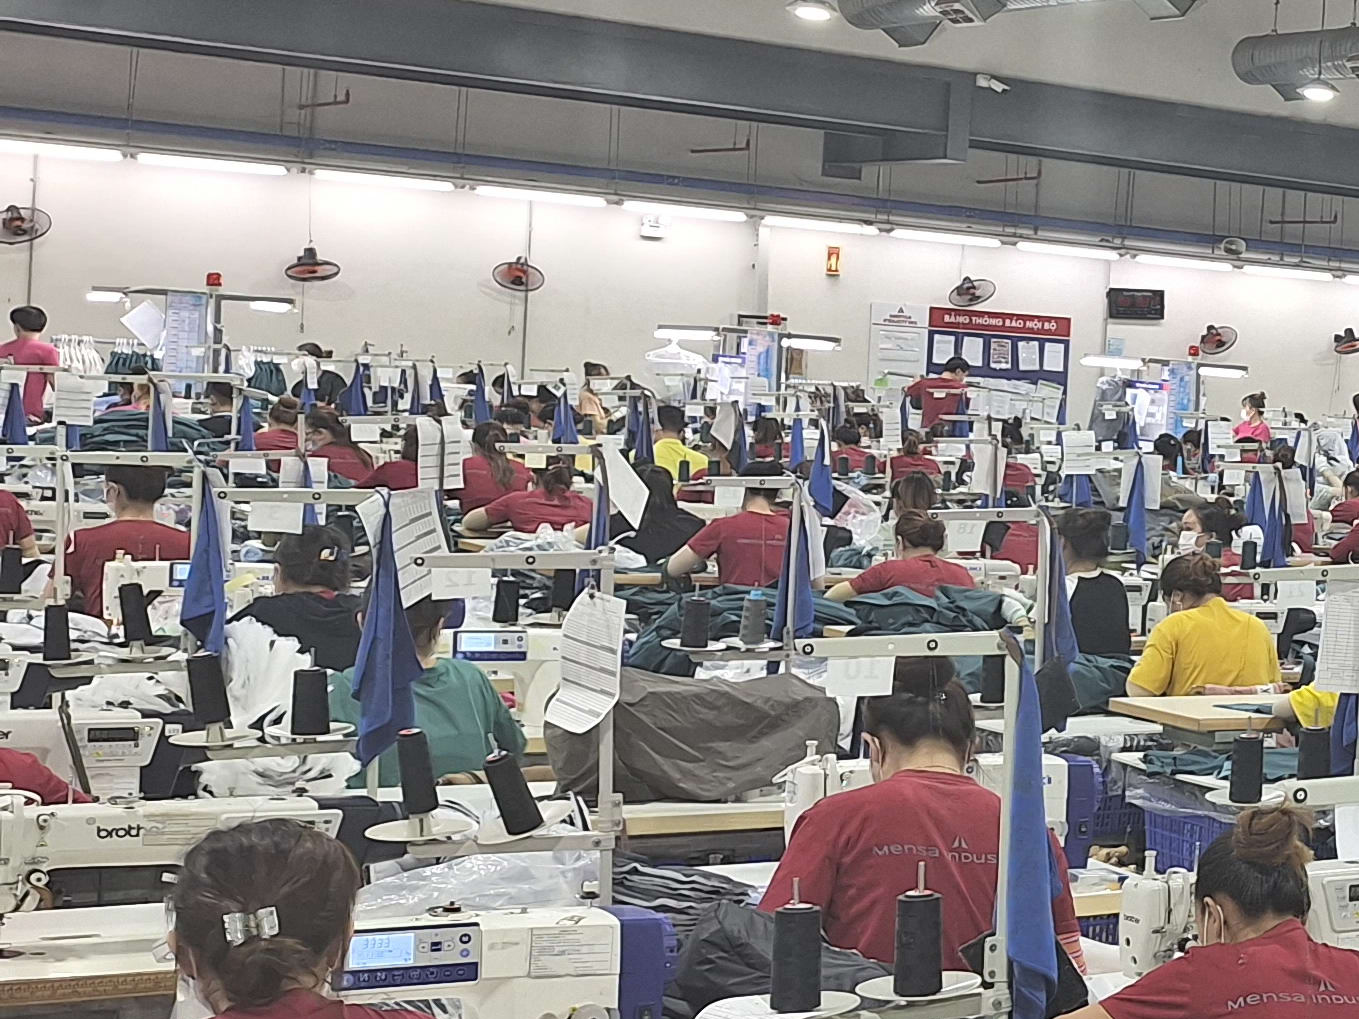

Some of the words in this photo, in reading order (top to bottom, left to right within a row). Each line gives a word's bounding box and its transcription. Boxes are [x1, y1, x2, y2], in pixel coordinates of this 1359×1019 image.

[943, 314, 970, 324] BẢNG
[971, 315, 1003, 326] THÔNG
[1004, 316, 1024, 328] BÁO
[1025, 318, 1042, 330] NỘI
[1043, 319, 1057, 332] BỘ
[1227, 992, 1305, 1012] Mensa
